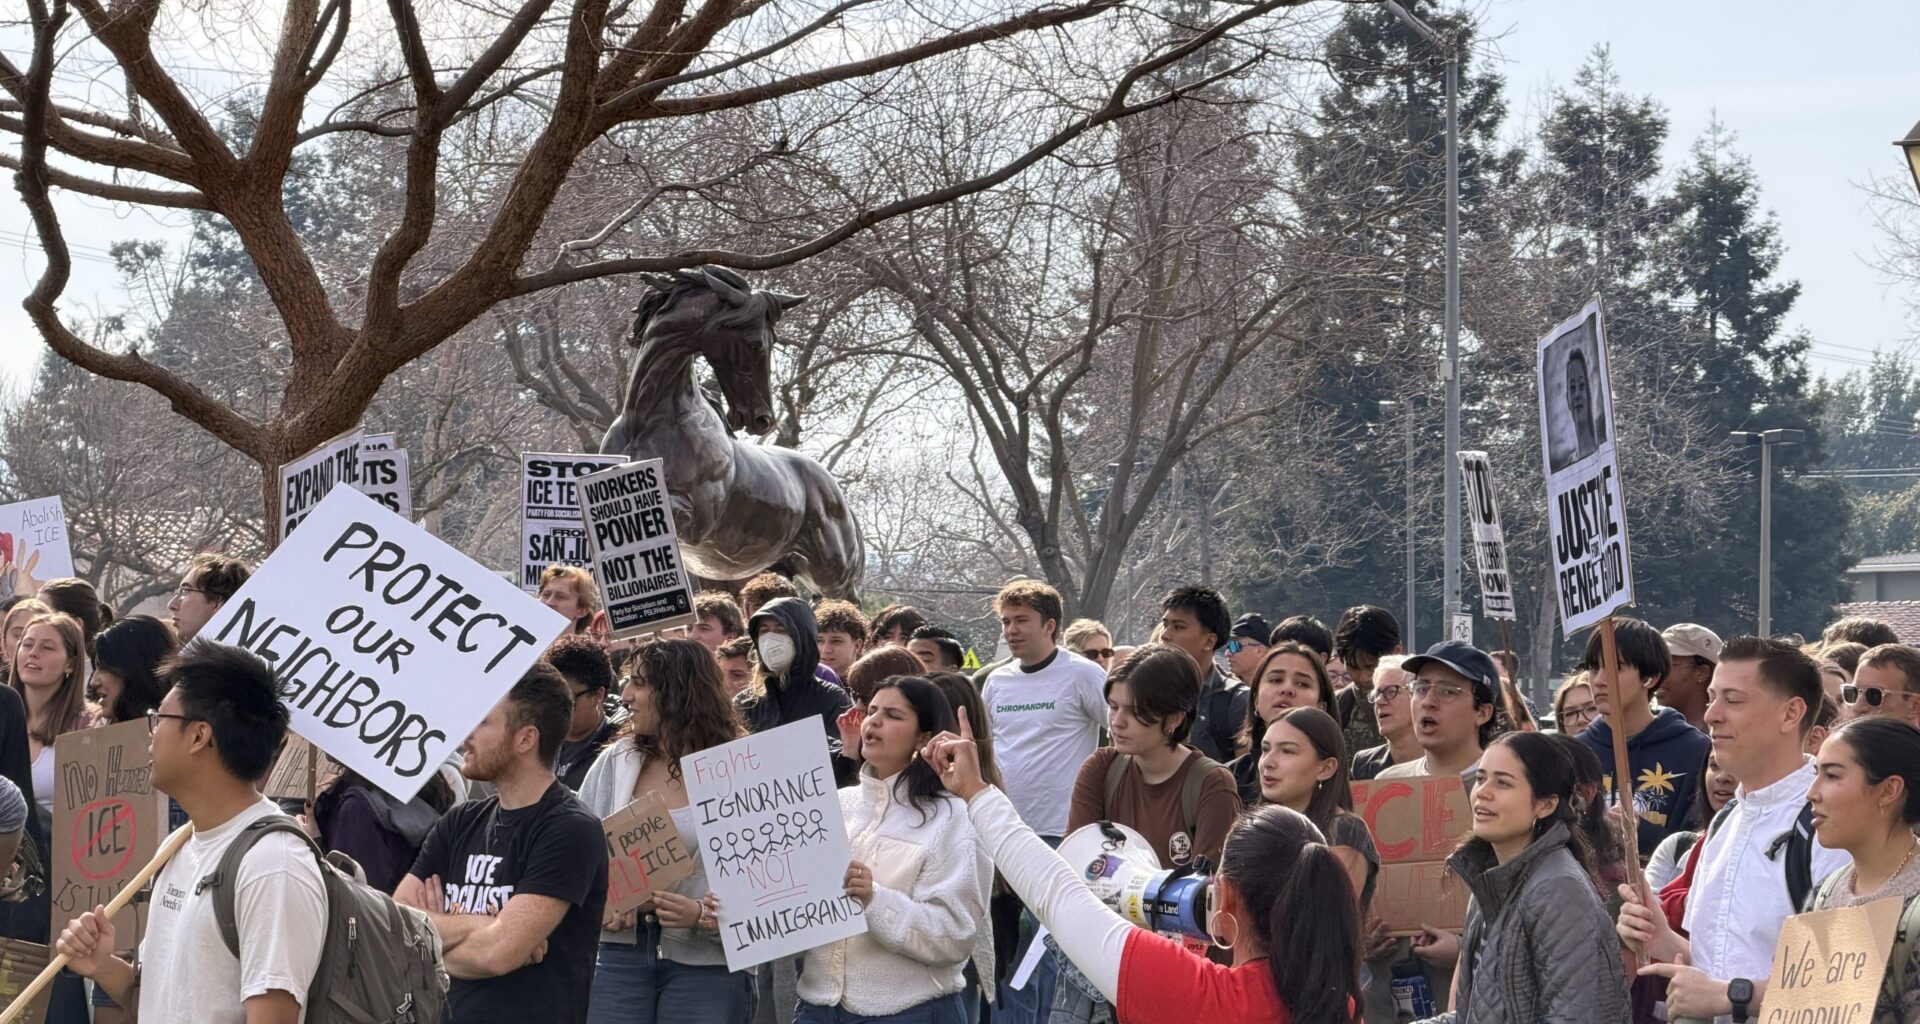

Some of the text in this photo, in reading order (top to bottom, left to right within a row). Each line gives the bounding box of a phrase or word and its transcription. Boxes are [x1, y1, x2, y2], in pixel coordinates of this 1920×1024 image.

[286, 455, 333, 517] EXPAND
[336, 442, 360, 484] THE
[528, 480, 579, 506] ICE TE
[585, 467, 657, 505] WORKERS
[590, 489, 663, 522] SHOULD HAVE
[34, 526, 60, 546] ICE
[529, 534, 564, 561] SAN
[594, 507, 669, 551] POWER
[602, 554, 637, 585] NOT
[640, 545, 676, 575] THE
[323, 522, 537, 673] PROTECT
[607, 571, 680, 601] BILLIONAIRES!
[1560, 556, 1603, 619] RENEE
[325, 605, 415, 674] OUR
[214, 597, 447, 777] NEIGHBORS
[996, 700, 1056, 713] CHROMAKOPIA
[694, 743, 761, 798] Fight
[697, 766, 826, 825] IGNORANCE
[87, 805, 126, 858] ICE
[618, 816, 667, 856] people
[640, 836, 687, 875] ICE
[747, 849, 796, 890] NOT
[729, 894, 864, 951] IMMIGRANTS
[1164, 903, 1178, 914] Land
[1781, 940, 1867, 990] We are
